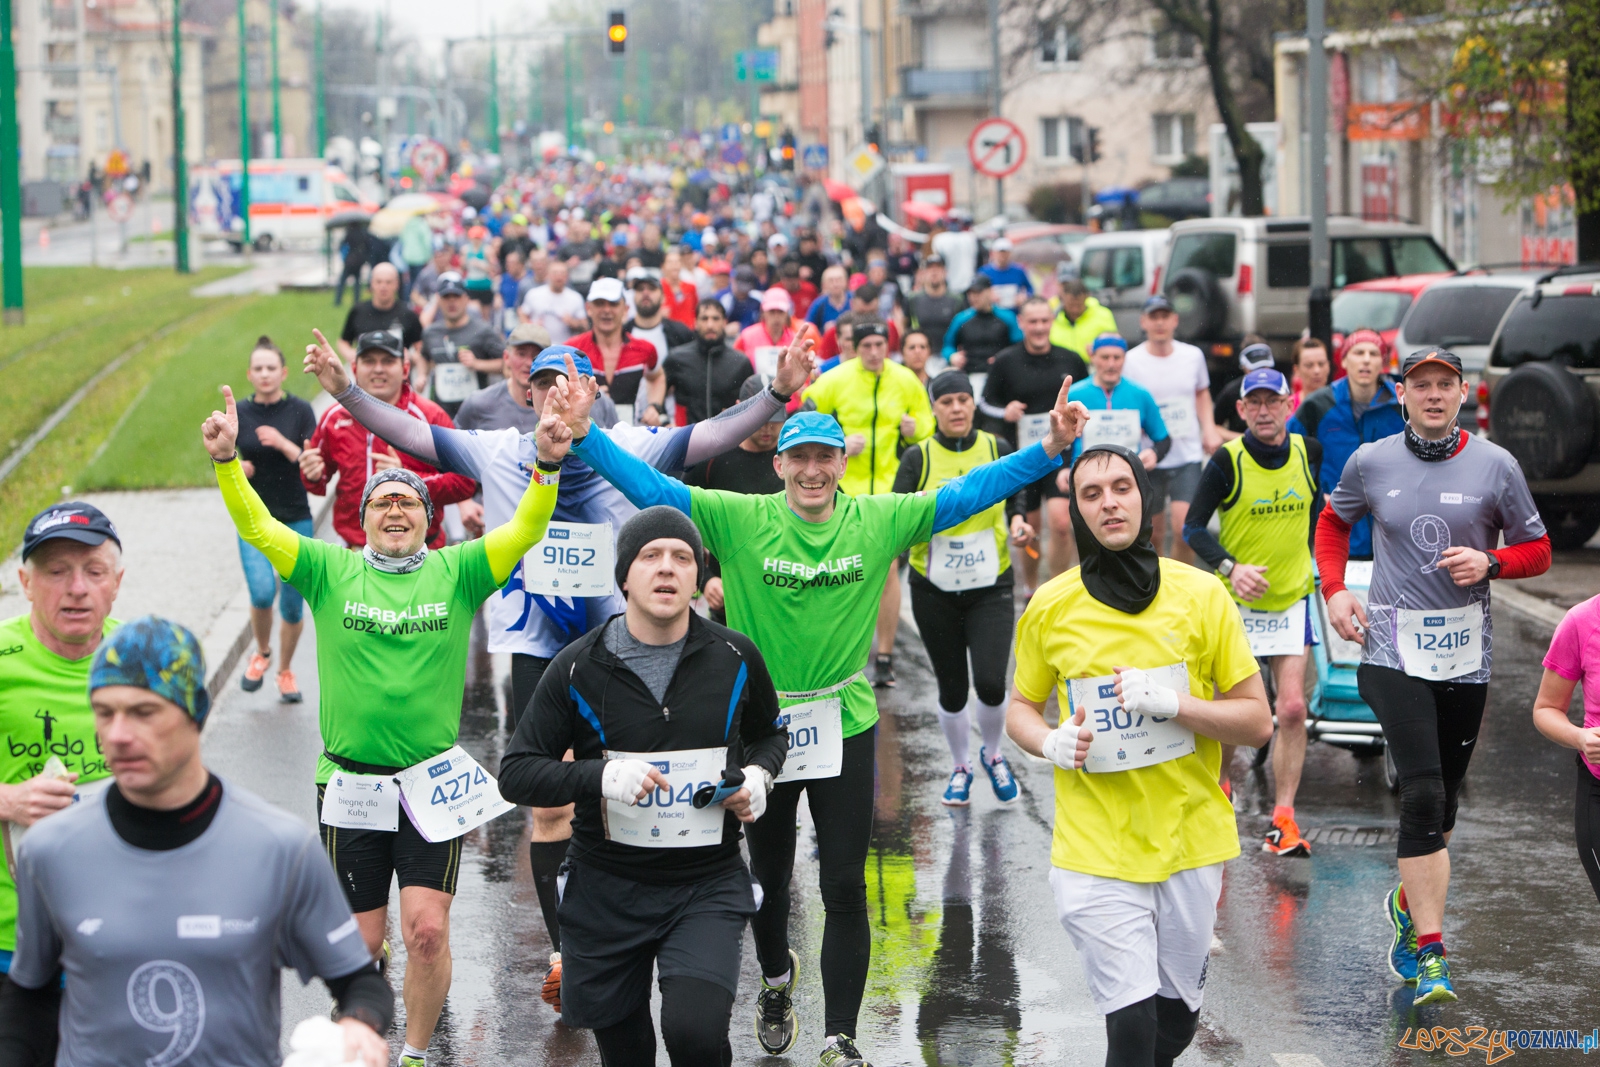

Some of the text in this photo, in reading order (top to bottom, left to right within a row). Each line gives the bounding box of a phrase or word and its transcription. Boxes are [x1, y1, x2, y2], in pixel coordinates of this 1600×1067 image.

[550, 530, 568, 538] 9.PKO
[1410, 514, 1451, 574] 9
[543, 545, 596, 567] 9162
[944, 549, 986, 569] 2784
[557, 567, 579, 575] Michał
[763, 554, 863, 579] HERBALIFE
[762, 569, 865, 590] ODŻYWIANIE
[343, 600, 449, 623] HERBALIFE
[342, 617, 449, 636] ODŻYWIANIE
[1243, 616, 1291, 634] 5584
[1414, 628, 1471, 651] 12416
[1120, 730, 1149, 741] Marcin
[1144, 747, 1156, 755] 4F
[431, 764, 449, 776] 9.PKO
[430, 766, 488, 806] 4274
[338, 796, 378, 808] biegnę dla
[347, 809, 368, 818] Kuby
[657, 811, 685, 819] Maciej
[678, 829, 690, 837] 4F
[127, 959, 206, 1067] 9
